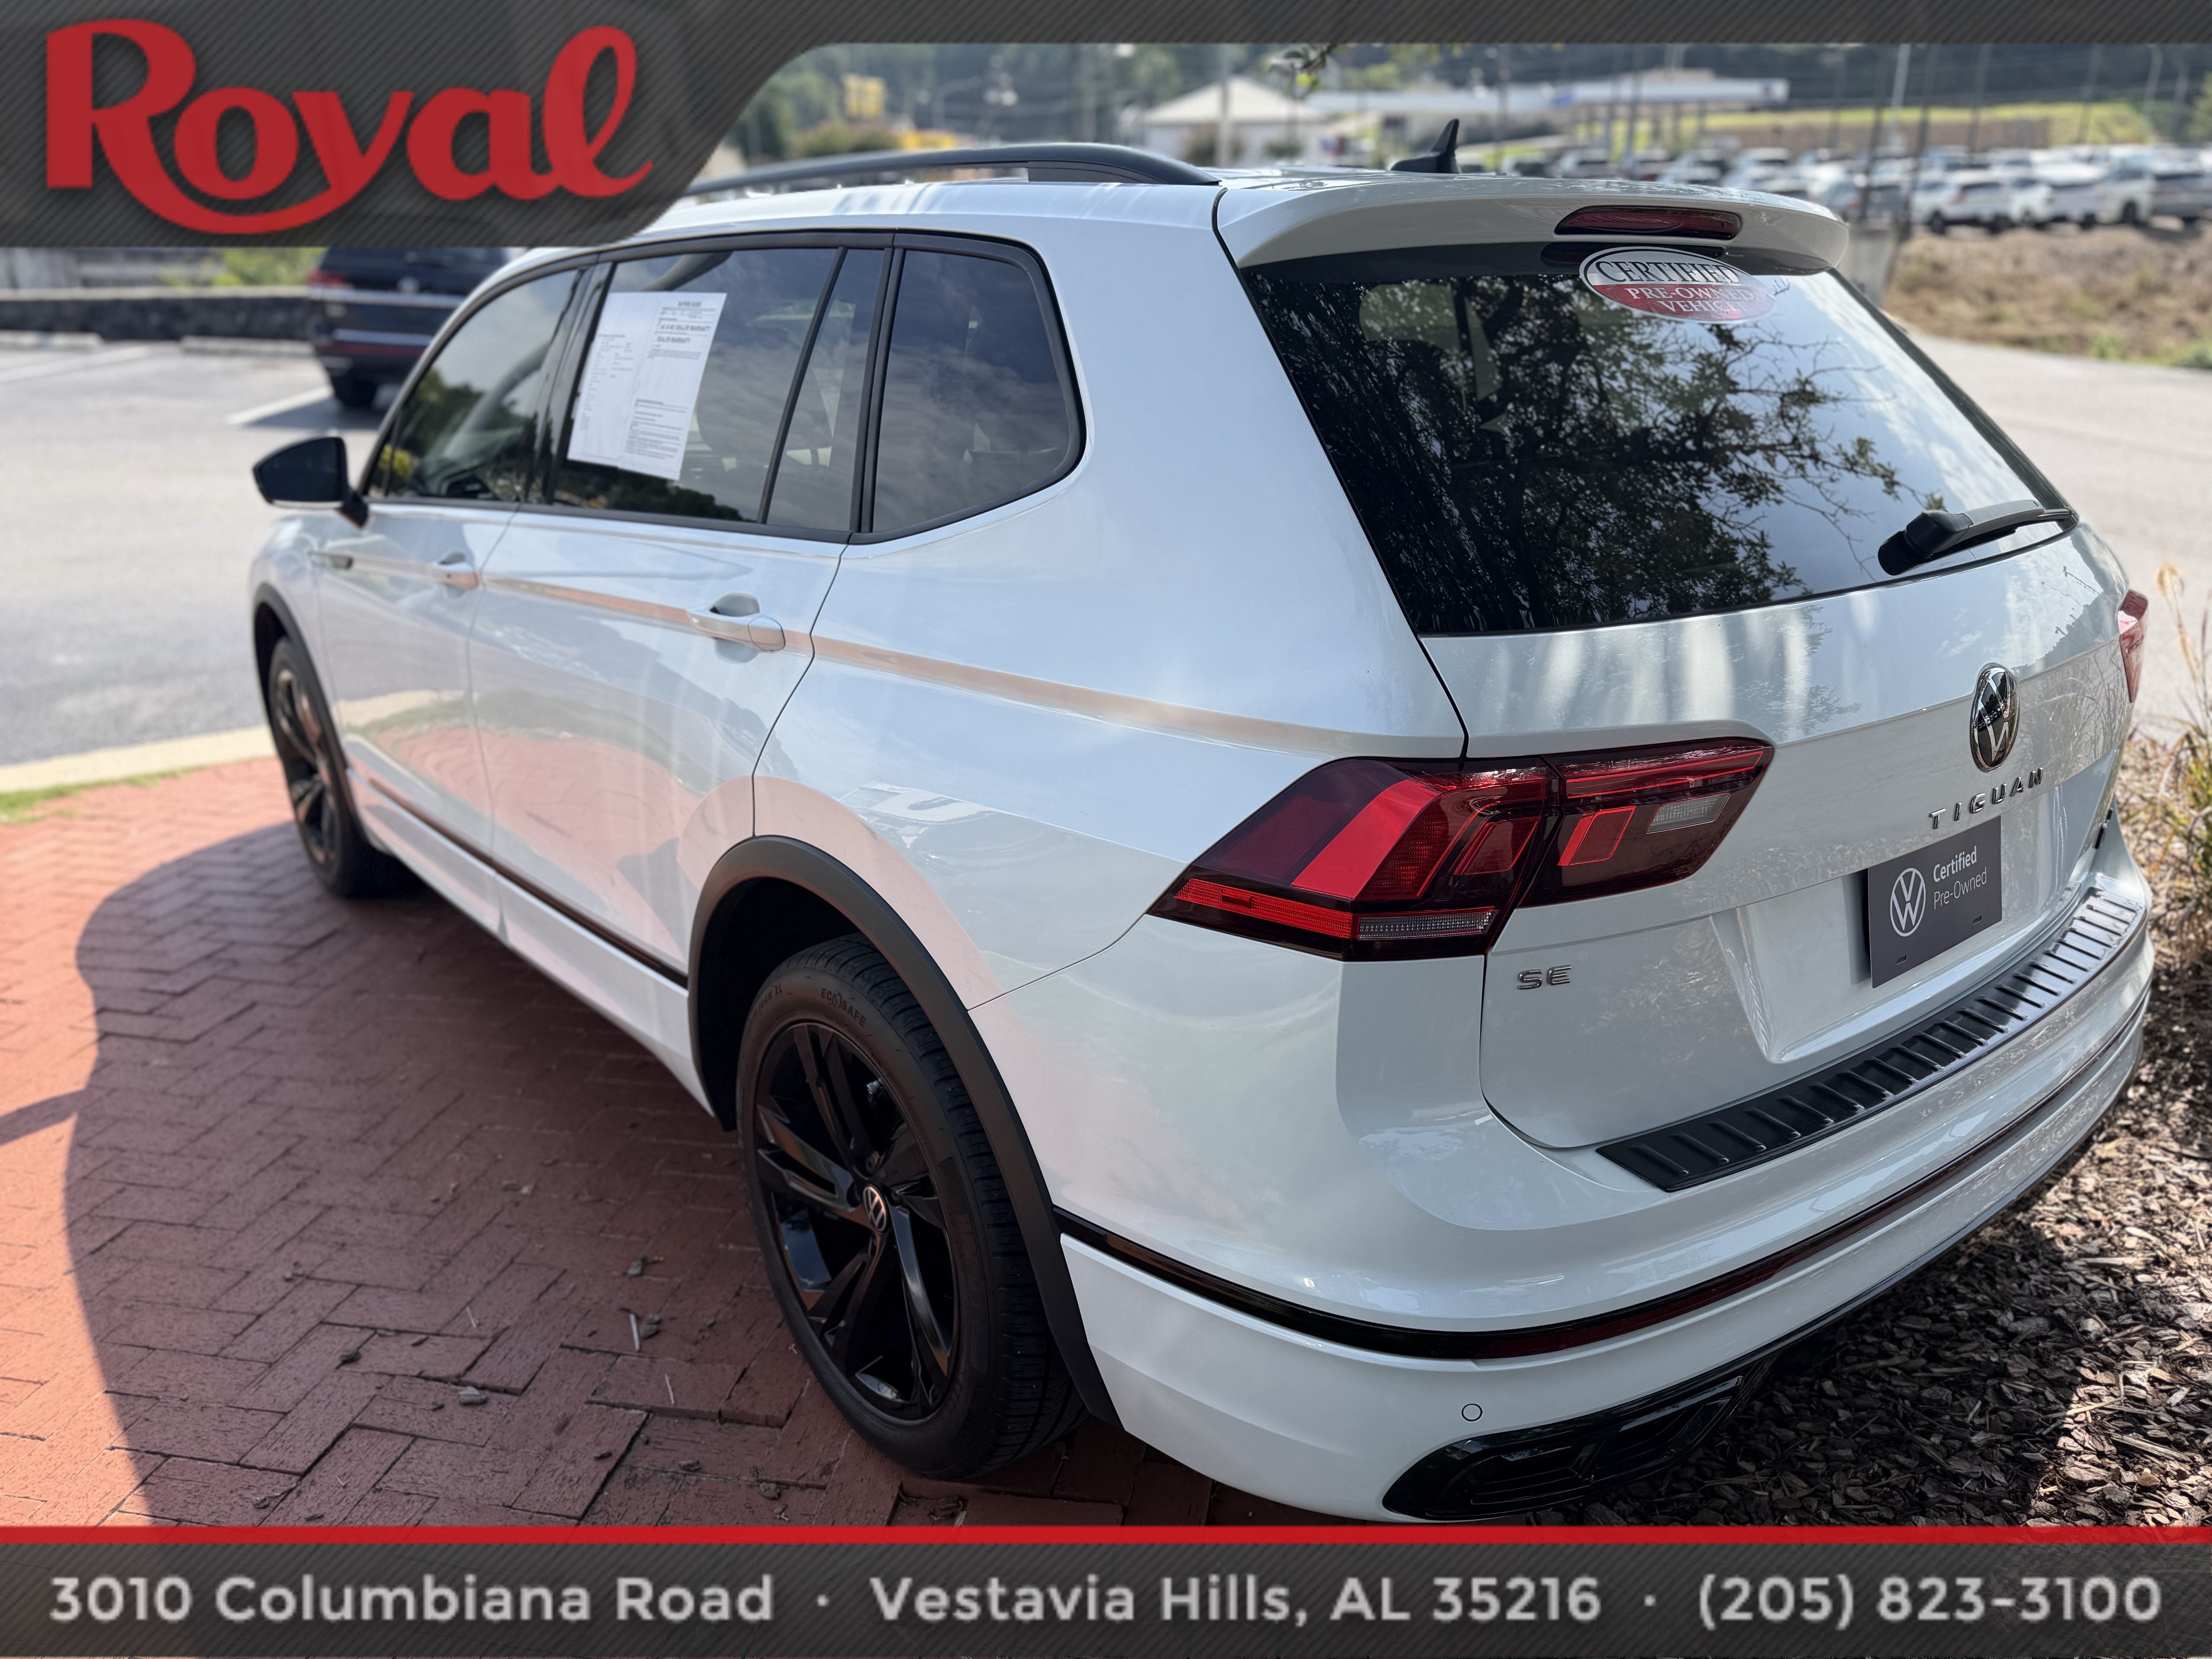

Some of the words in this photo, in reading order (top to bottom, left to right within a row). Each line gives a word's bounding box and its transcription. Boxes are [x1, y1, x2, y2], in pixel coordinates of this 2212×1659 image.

[1595, 261, 1740, 283] CERTIFIED
[1624, 287, 1755, 301] PRE-OWNED
[1928, 767, 2044, 830] TIGUAN
[1933, 845, 1977, 883] Certified
[1933, 867, 1987, 910] Pre-Owned
[1517, 964, 1572, 990] SE
